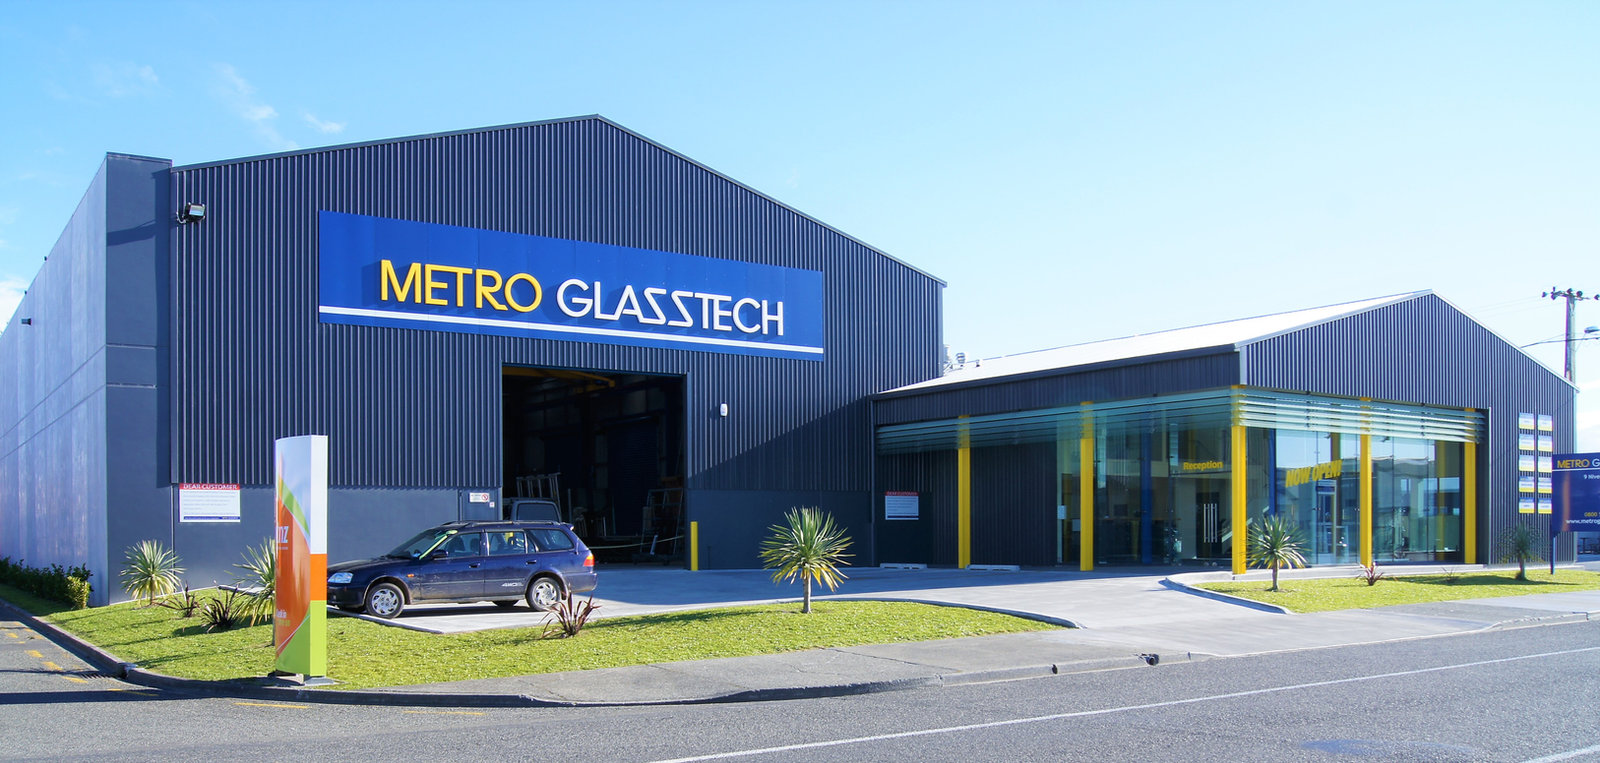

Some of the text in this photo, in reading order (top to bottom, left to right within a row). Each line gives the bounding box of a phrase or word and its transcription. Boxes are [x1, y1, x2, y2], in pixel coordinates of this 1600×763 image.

[379, 259, 784, 336] METRO GLASSTECH
[1184, 461, 1223, 471] Reception
[1557, 459, 1590, 468] METRO
[1286, 460, 1342, 487] NOW OPEN!
